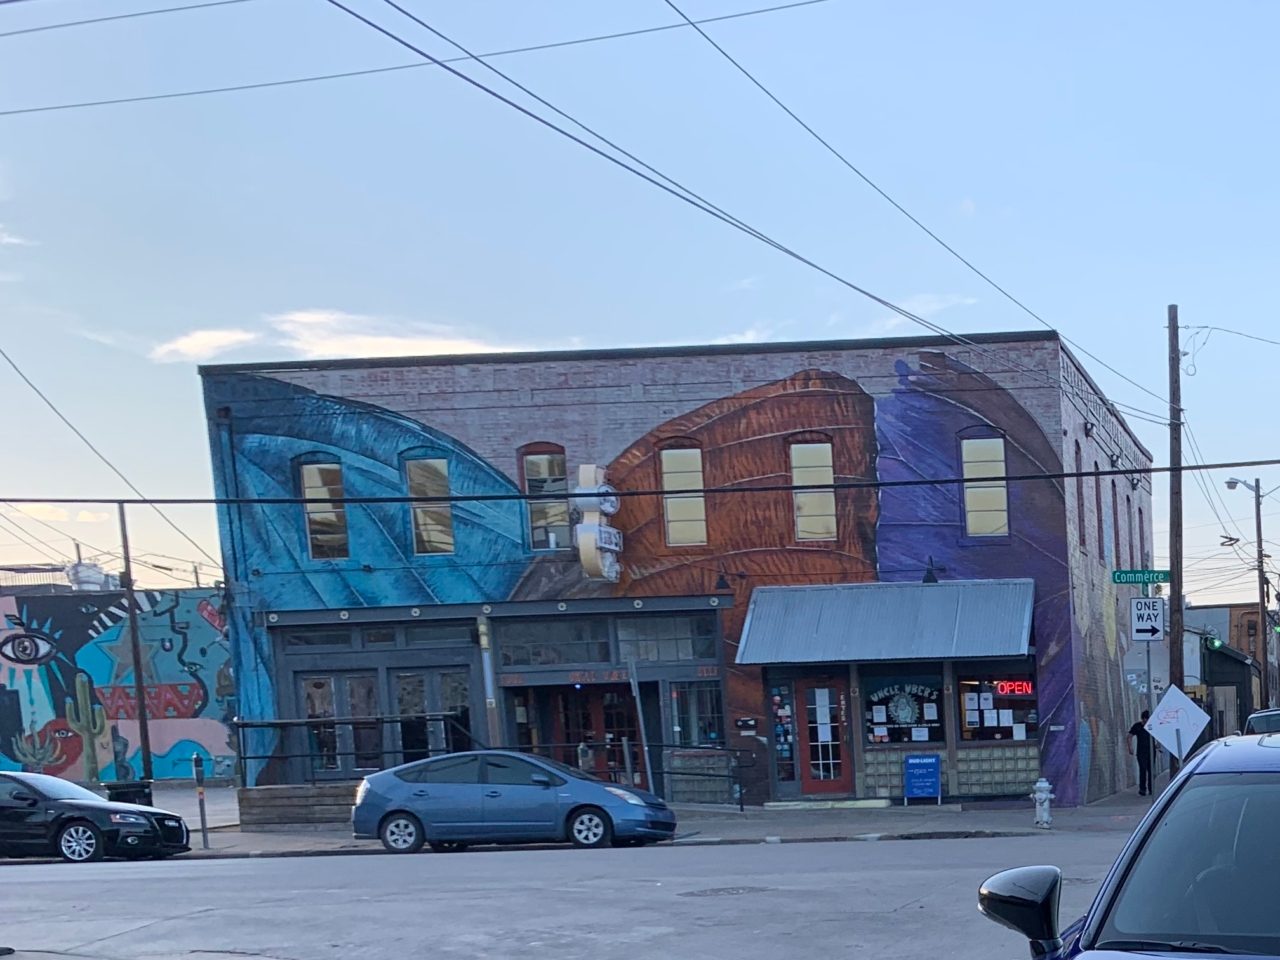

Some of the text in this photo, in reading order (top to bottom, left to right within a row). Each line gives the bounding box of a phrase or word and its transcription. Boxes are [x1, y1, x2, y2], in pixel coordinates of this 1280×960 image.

[1115, 571, 1164, 582] Commerce
[1136, 601, 1158, 611] ONE
[1136, 613, 1159, 623] WAY
[870, 685, 900, 702] UNCLE
[998, 682, 1032, 694] OPEN
